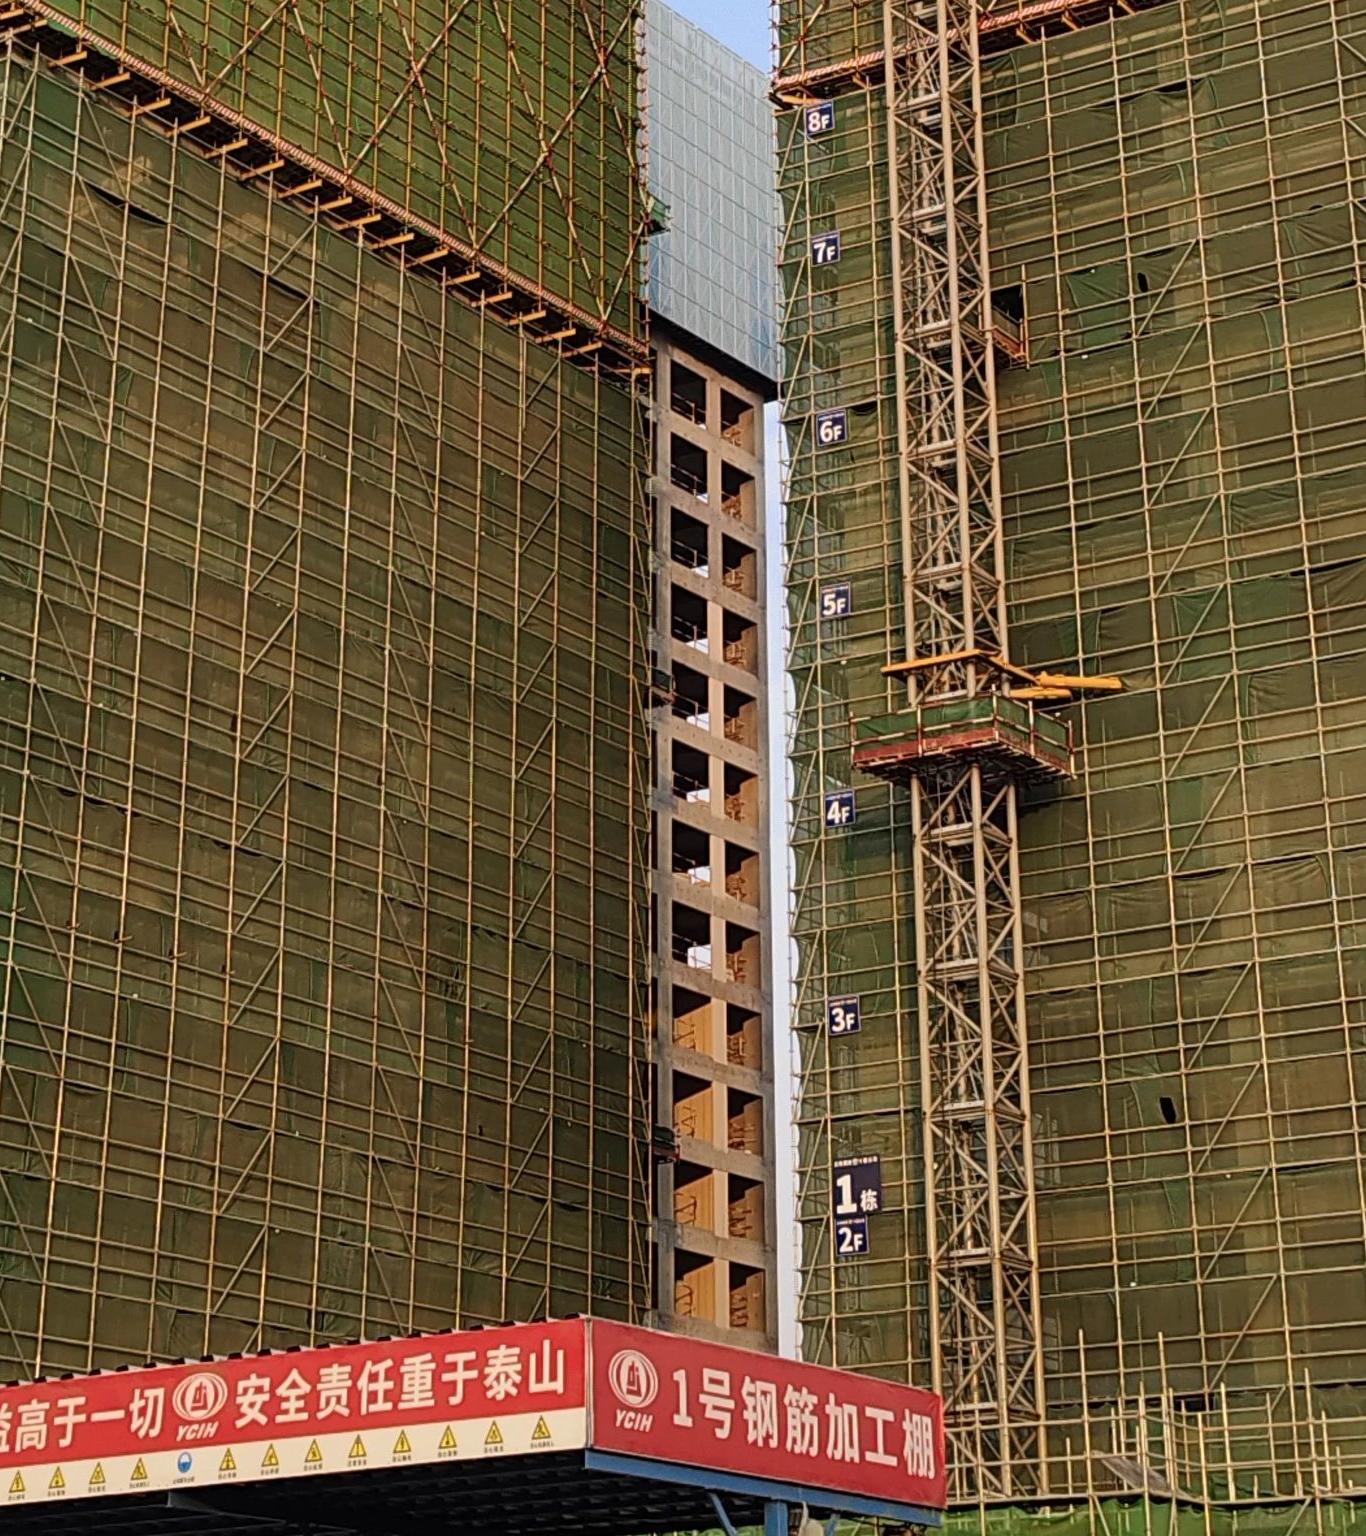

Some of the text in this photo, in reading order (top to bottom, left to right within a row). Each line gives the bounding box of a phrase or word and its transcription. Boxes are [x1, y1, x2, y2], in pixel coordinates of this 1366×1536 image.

[808, 112, 829, 131] 8F
[813, 242, 835, 263] 7F
[820, 421, 842, 442] 6F
[822, 593, 846, 616] 5F
[827, 800, 850, 824] 4F
[831, 1007, 855, 1032] 3F
[836, 1174, 878, 1214] 1栋
[838, 1226, 863, 1253] 2F
[234, 1339, 565, 1430] 安全责任重于泰山
[175, 1420, 219, 1442] YCIH
[614, 1408, 653, 1433] YCIH
[672, 1368, 936, 1481] 1号钢筋加工棚
